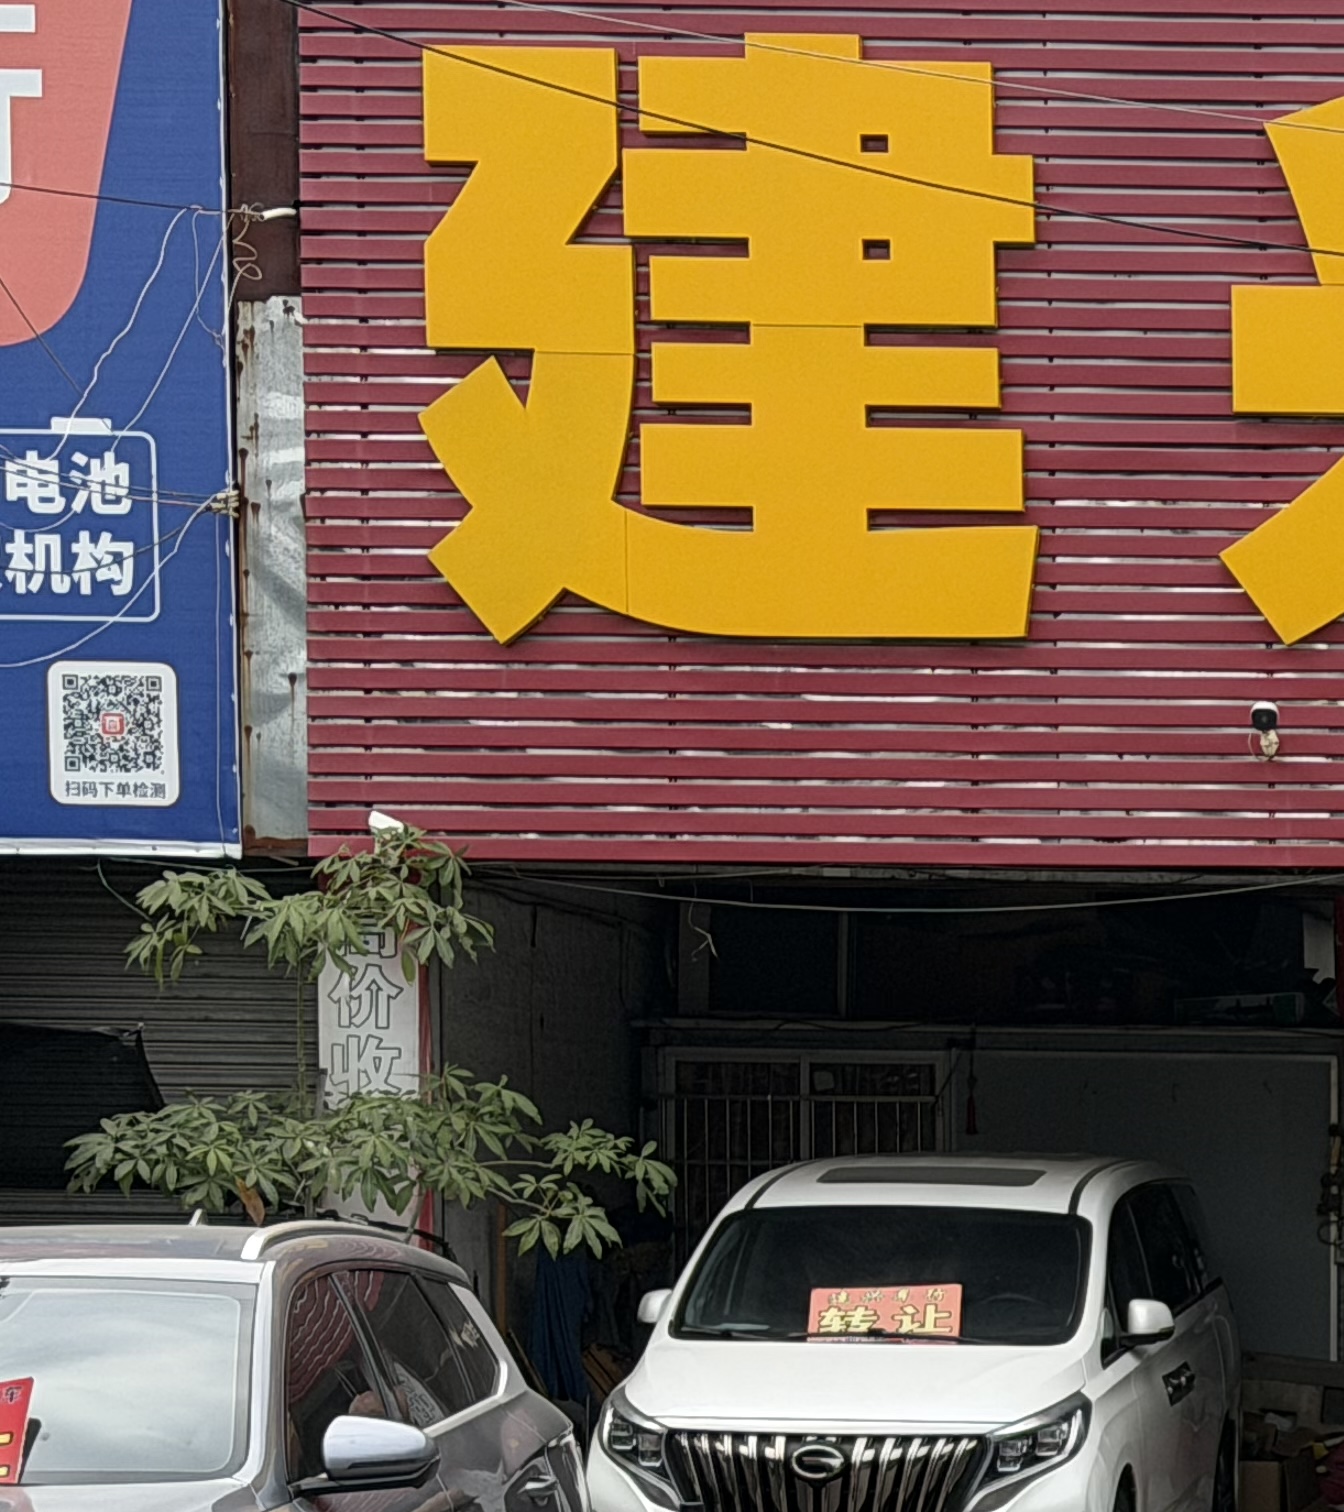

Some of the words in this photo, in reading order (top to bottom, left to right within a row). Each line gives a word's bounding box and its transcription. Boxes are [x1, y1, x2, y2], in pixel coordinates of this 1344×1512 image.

[4, 449, 134, 516] 电池
[0, 530, 135, 597] 机构
[65, 779, 167, 800] 扫码下单检测
[818, 1302, 955, 1336] 转让
